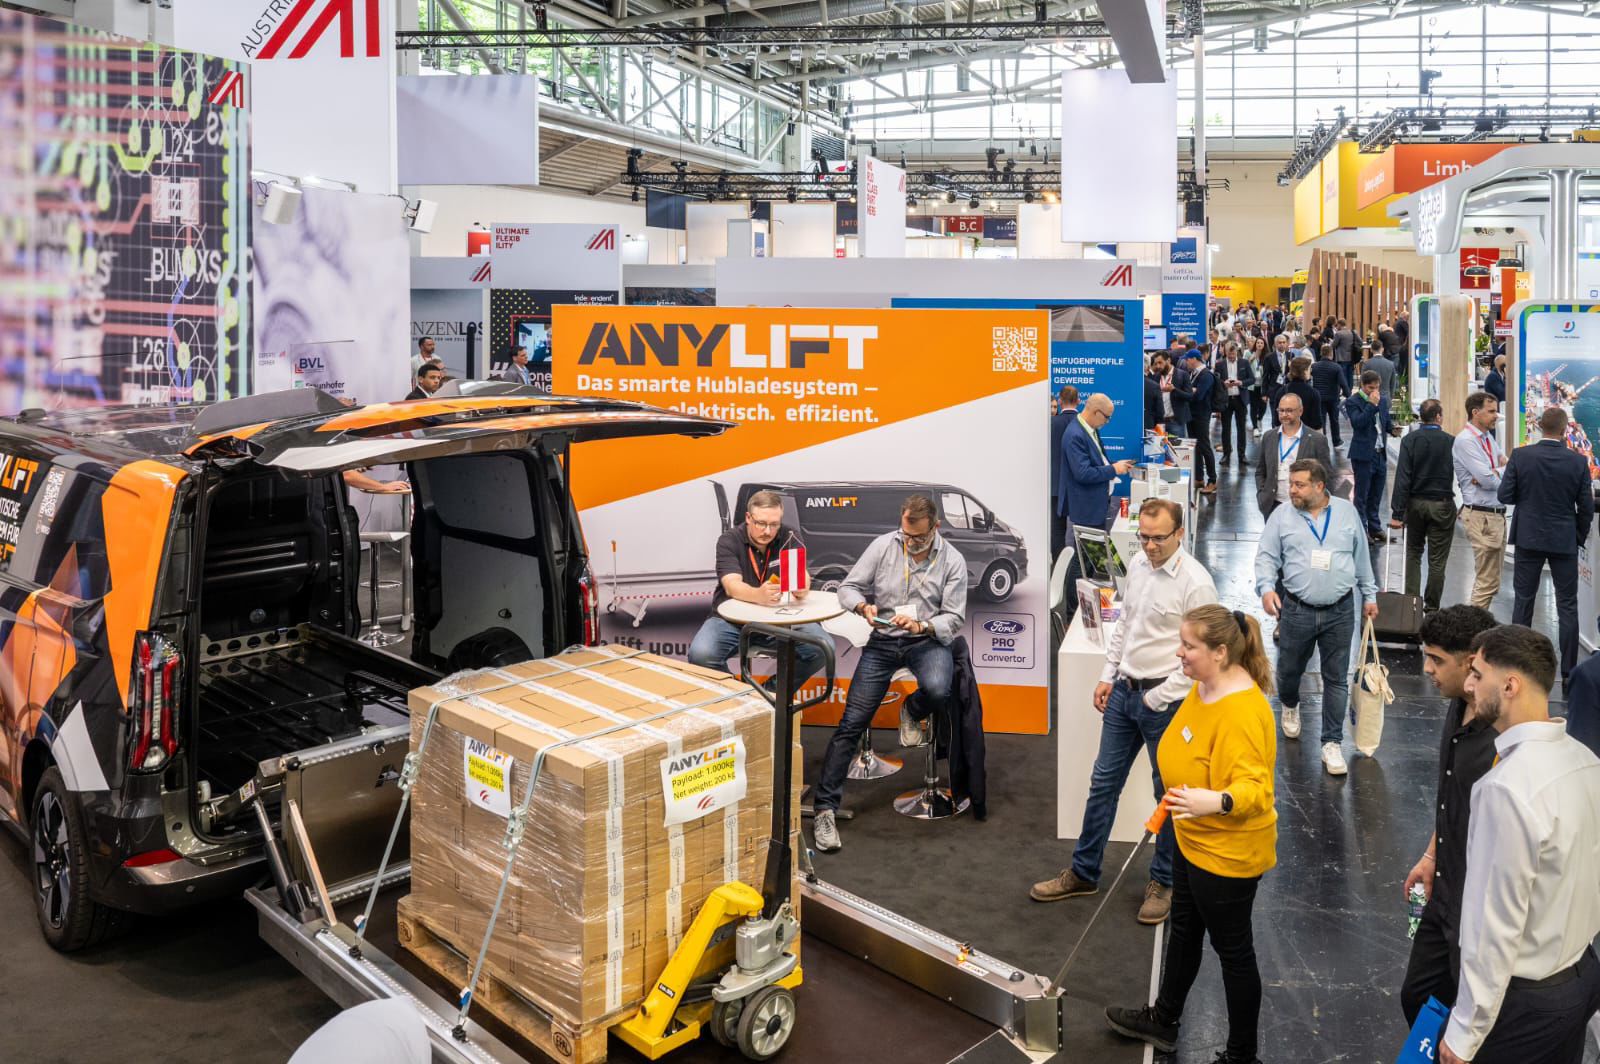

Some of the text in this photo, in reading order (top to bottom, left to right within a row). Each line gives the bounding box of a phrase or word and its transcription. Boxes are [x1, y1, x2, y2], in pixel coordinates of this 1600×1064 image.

[959, 221, 977, 233] B,C
[131, 336, 165, 371] L26
[576, 322, 878, 370] ANYLIFT
[299, 357, 325, 369] BVL
[1053, 367, 1096, 375] INDUSTRIE
[577, 374, 614, 392] Das
[618, 376, 691, 393] smarte
[696, 376, 859, 399] Hubladesystem
[1053, 376, 1095, 384] GEWERBE
[785, 404, 879, 423] effizient.
[805, 497, 858, 508] ANYLIFT
[990, 620, 1017, 633] Ford
[991, 637, 1015, 648] PRO
[981, 653, 1027, 664] Convertor
[468, 739, 509, 766] ANYLIFT
[668, 742, 737, 776] ANYLIFT
[671, 760, 736, 788] Payload: 1.000kg
[673, 771, 737, 800] Net weight: 200 kg
